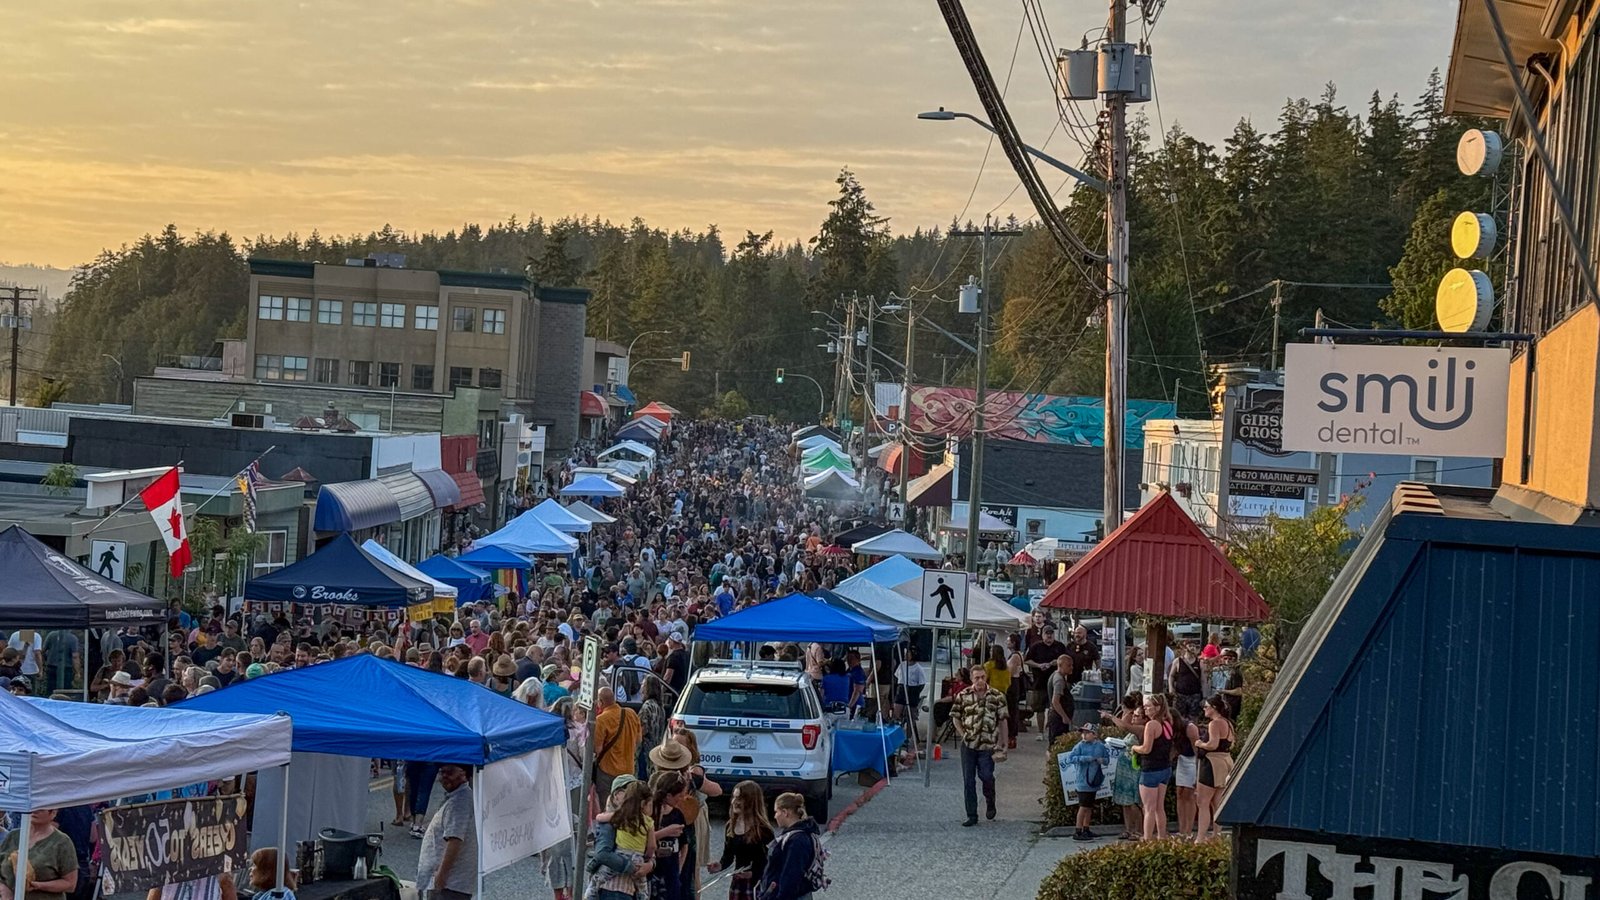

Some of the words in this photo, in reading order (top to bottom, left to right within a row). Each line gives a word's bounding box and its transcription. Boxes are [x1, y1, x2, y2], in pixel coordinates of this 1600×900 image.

[1240, 413, 1284, 427] GIBS
[888, 423, 896, 432] P
[1239, 426, 1284, 440] CROS
[1317, 420, 1403, 445] dental
[1235, 471, 1257, 479] 4670
[1260, 472, 1295, 482] MARINE
[1269, 485, 1303, 496] gallery
[311, 585, 359, 601] Brooks
[717, 718, 771, 728] POLICE
[1255, 838, 1469, 900] THE
